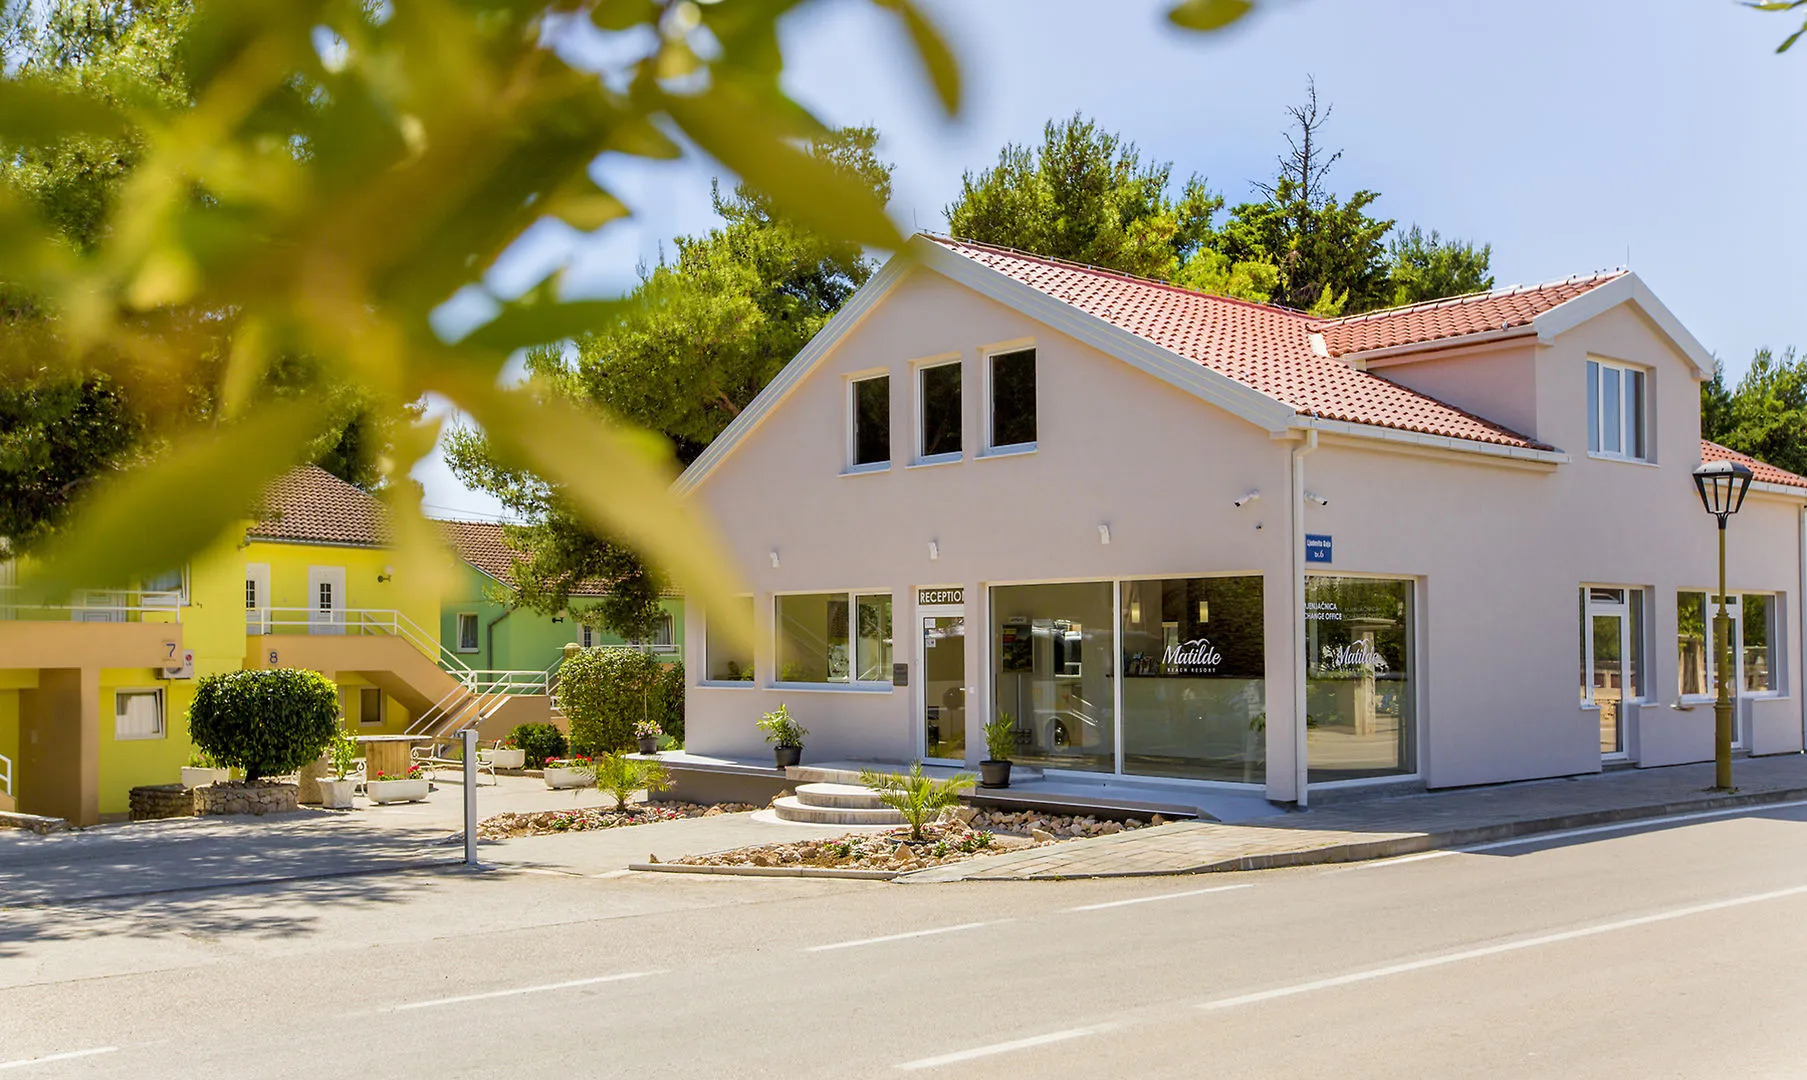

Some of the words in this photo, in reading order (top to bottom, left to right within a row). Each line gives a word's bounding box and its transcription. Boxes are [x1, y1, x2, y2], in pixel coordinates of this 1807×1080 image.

[1305, 601, 1338, 610] JENJAČNICA
[1325, 612, 1342, 620] OFFICE
[166, 643, 176, 657] 7
[1162, 644, 1222, 665] Matilde
[1336, 645, 1380, 666] Matilde
[269, 651, 279, 664] 8
